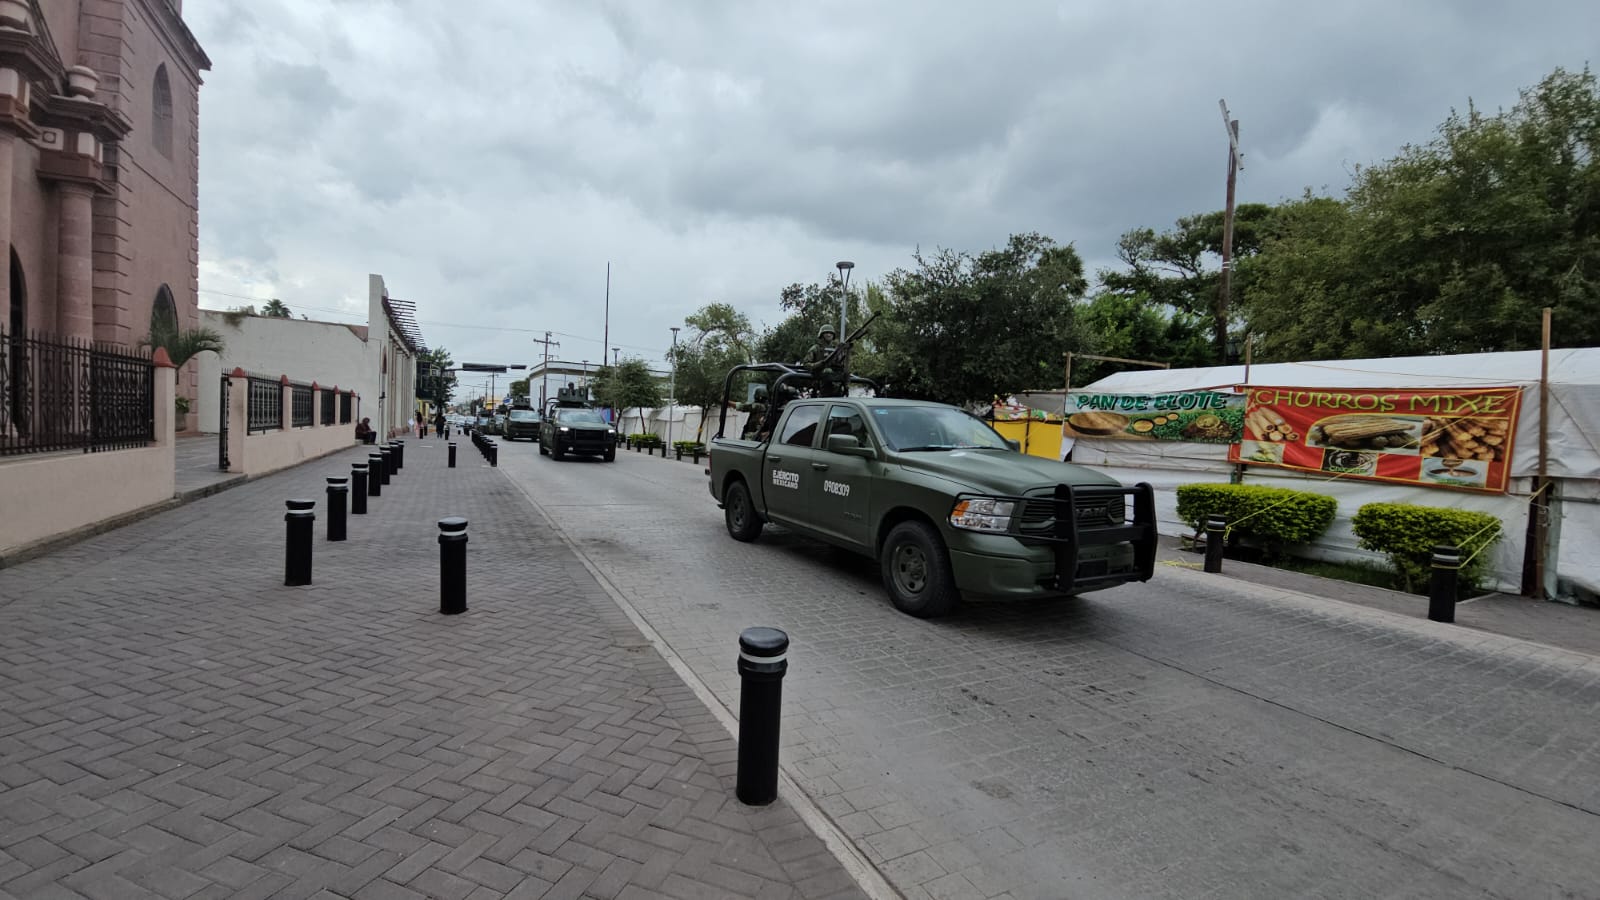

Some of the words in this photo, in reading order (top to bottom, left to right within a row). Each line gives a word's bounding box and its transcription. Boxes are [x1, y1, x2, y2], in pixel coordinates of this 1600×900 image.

[1076, 394, 1118, 411] PAN
[1118, 395, 1151, 411] DE
[1153, 392, 1232, 411] ELOTE
[1254, 389, 1401, 412] CHURROS
[1409, 394, 1507, 414] MIXE
[772, 469, 800, 483] EJÉRCITO
[772, 478, 799, 490] MEXICANO
[823, 480, 850, 497] 0908309
